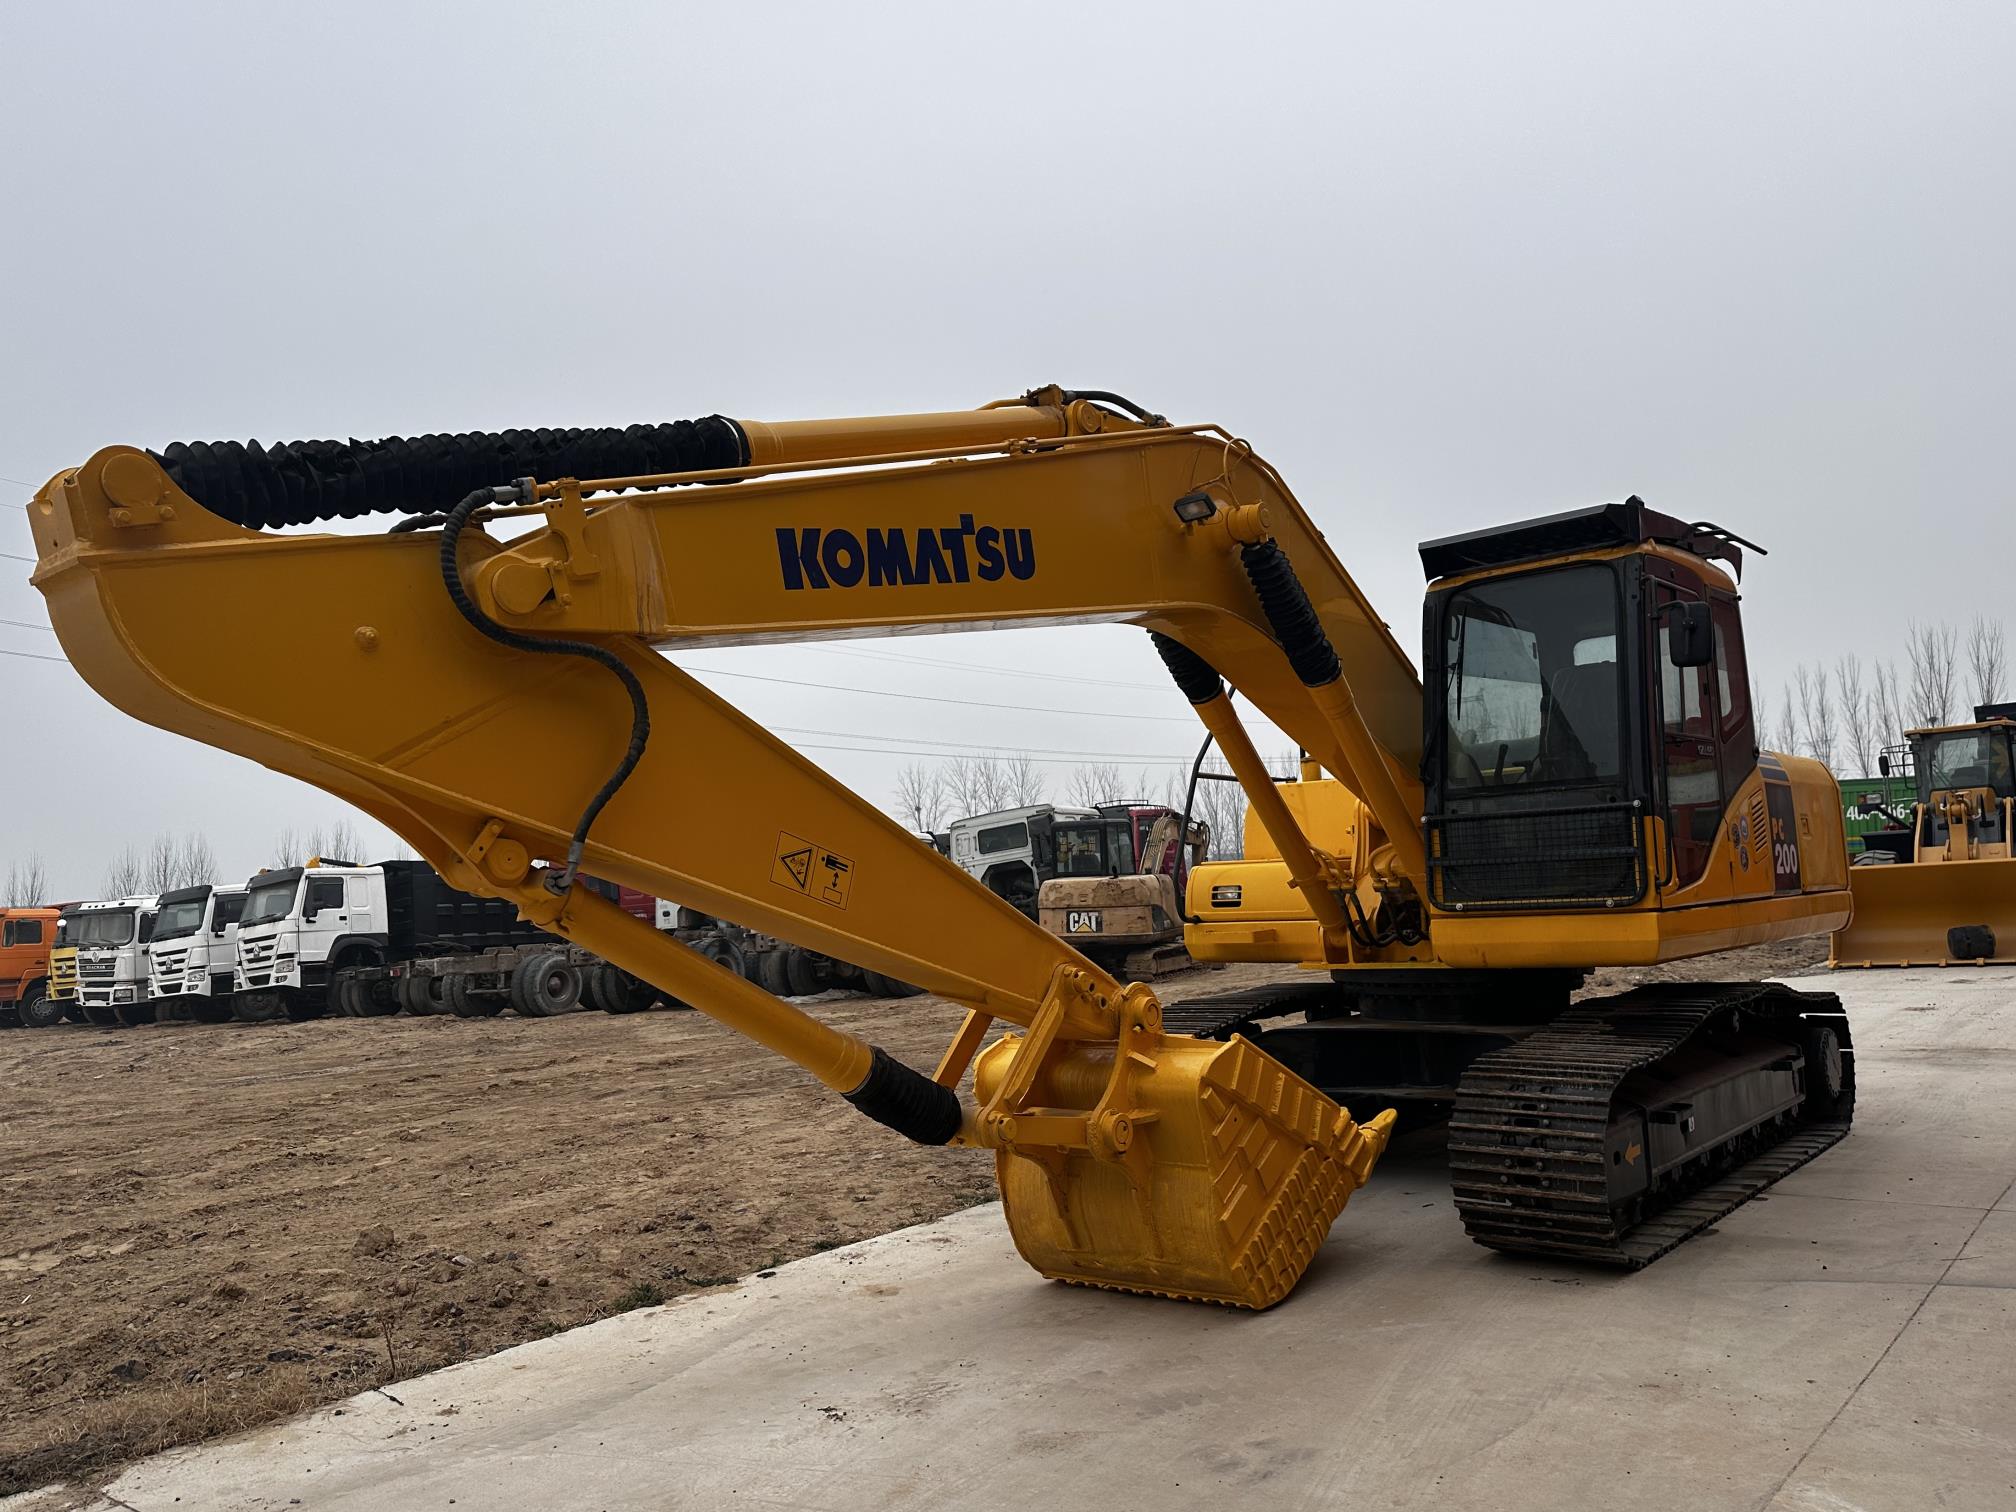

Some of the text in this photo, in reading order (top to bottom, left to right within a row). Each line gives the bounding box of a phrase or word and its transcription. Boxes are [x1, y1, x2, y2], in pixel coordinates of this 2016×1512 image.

[775, 513, 1036, 590] KOMATSU
[1771, 817, 1785, 840] PC
[1774, 843, 1798, 874] 200
[1069, 911, 1099, 932] CAT
